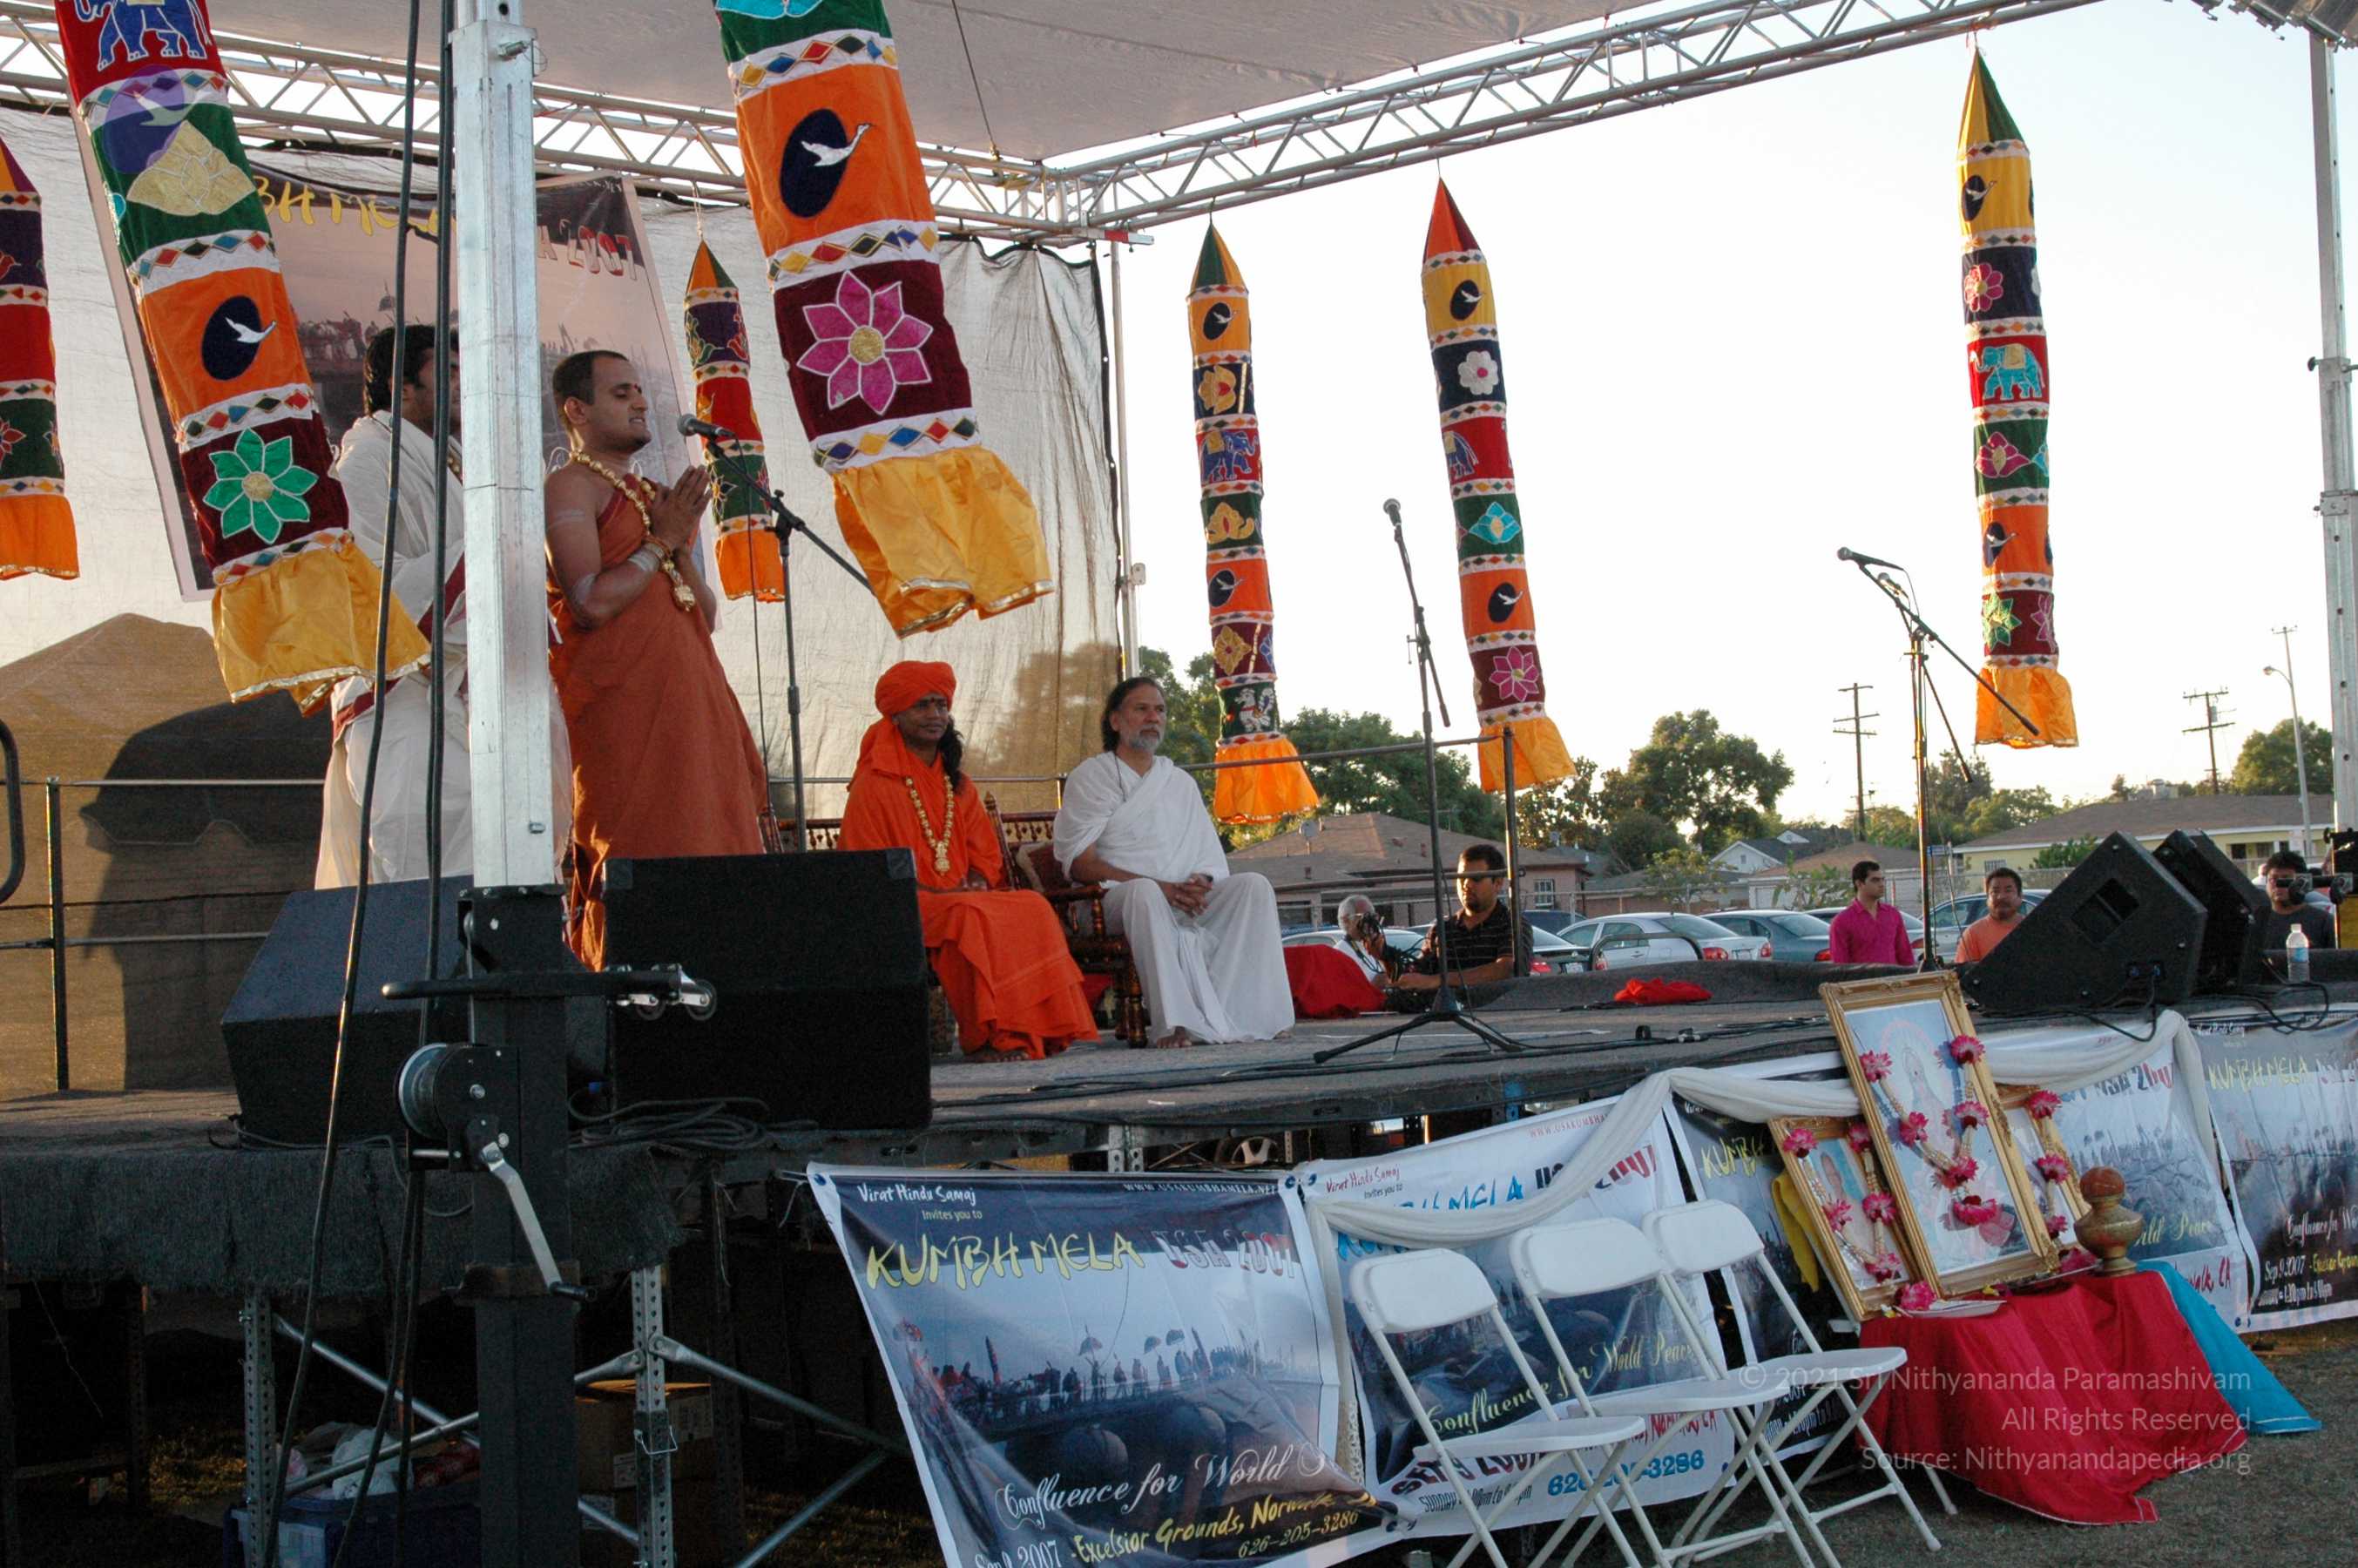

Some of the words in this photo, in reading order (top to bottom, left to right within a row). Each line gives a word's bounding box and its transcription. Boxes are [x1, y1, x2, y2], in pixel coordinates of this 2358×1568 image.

[857, 1182, 895, 1202] Virat
[895, 1184, 934, 1202] Hindu
[936, 1186, 976, 1206] Samaj
[1326, 1177, 1349, 1193] Virat
[1348, 1169, 1374, 1188] Hindu
[922, 1210, 953, 1220] Invites
[954, 1212, 971, 1221] you
[971, 1210, 983, 1220] to
[866, 1231, 1024, 1290] KUMBH
[1030, 1232, 1145, 1281] MELA
[995, 1473, 1131, 1531] Confluence
[1120, 1463, 1184, 1516] for
[1194, 1443, 1294, 1489] World
[1017, 1539, 1062, 1568] 2007
[1156, 1506, 1246, 1555] Grounds,
[1238, 1510, 1360, 1559] 626-205-3286
